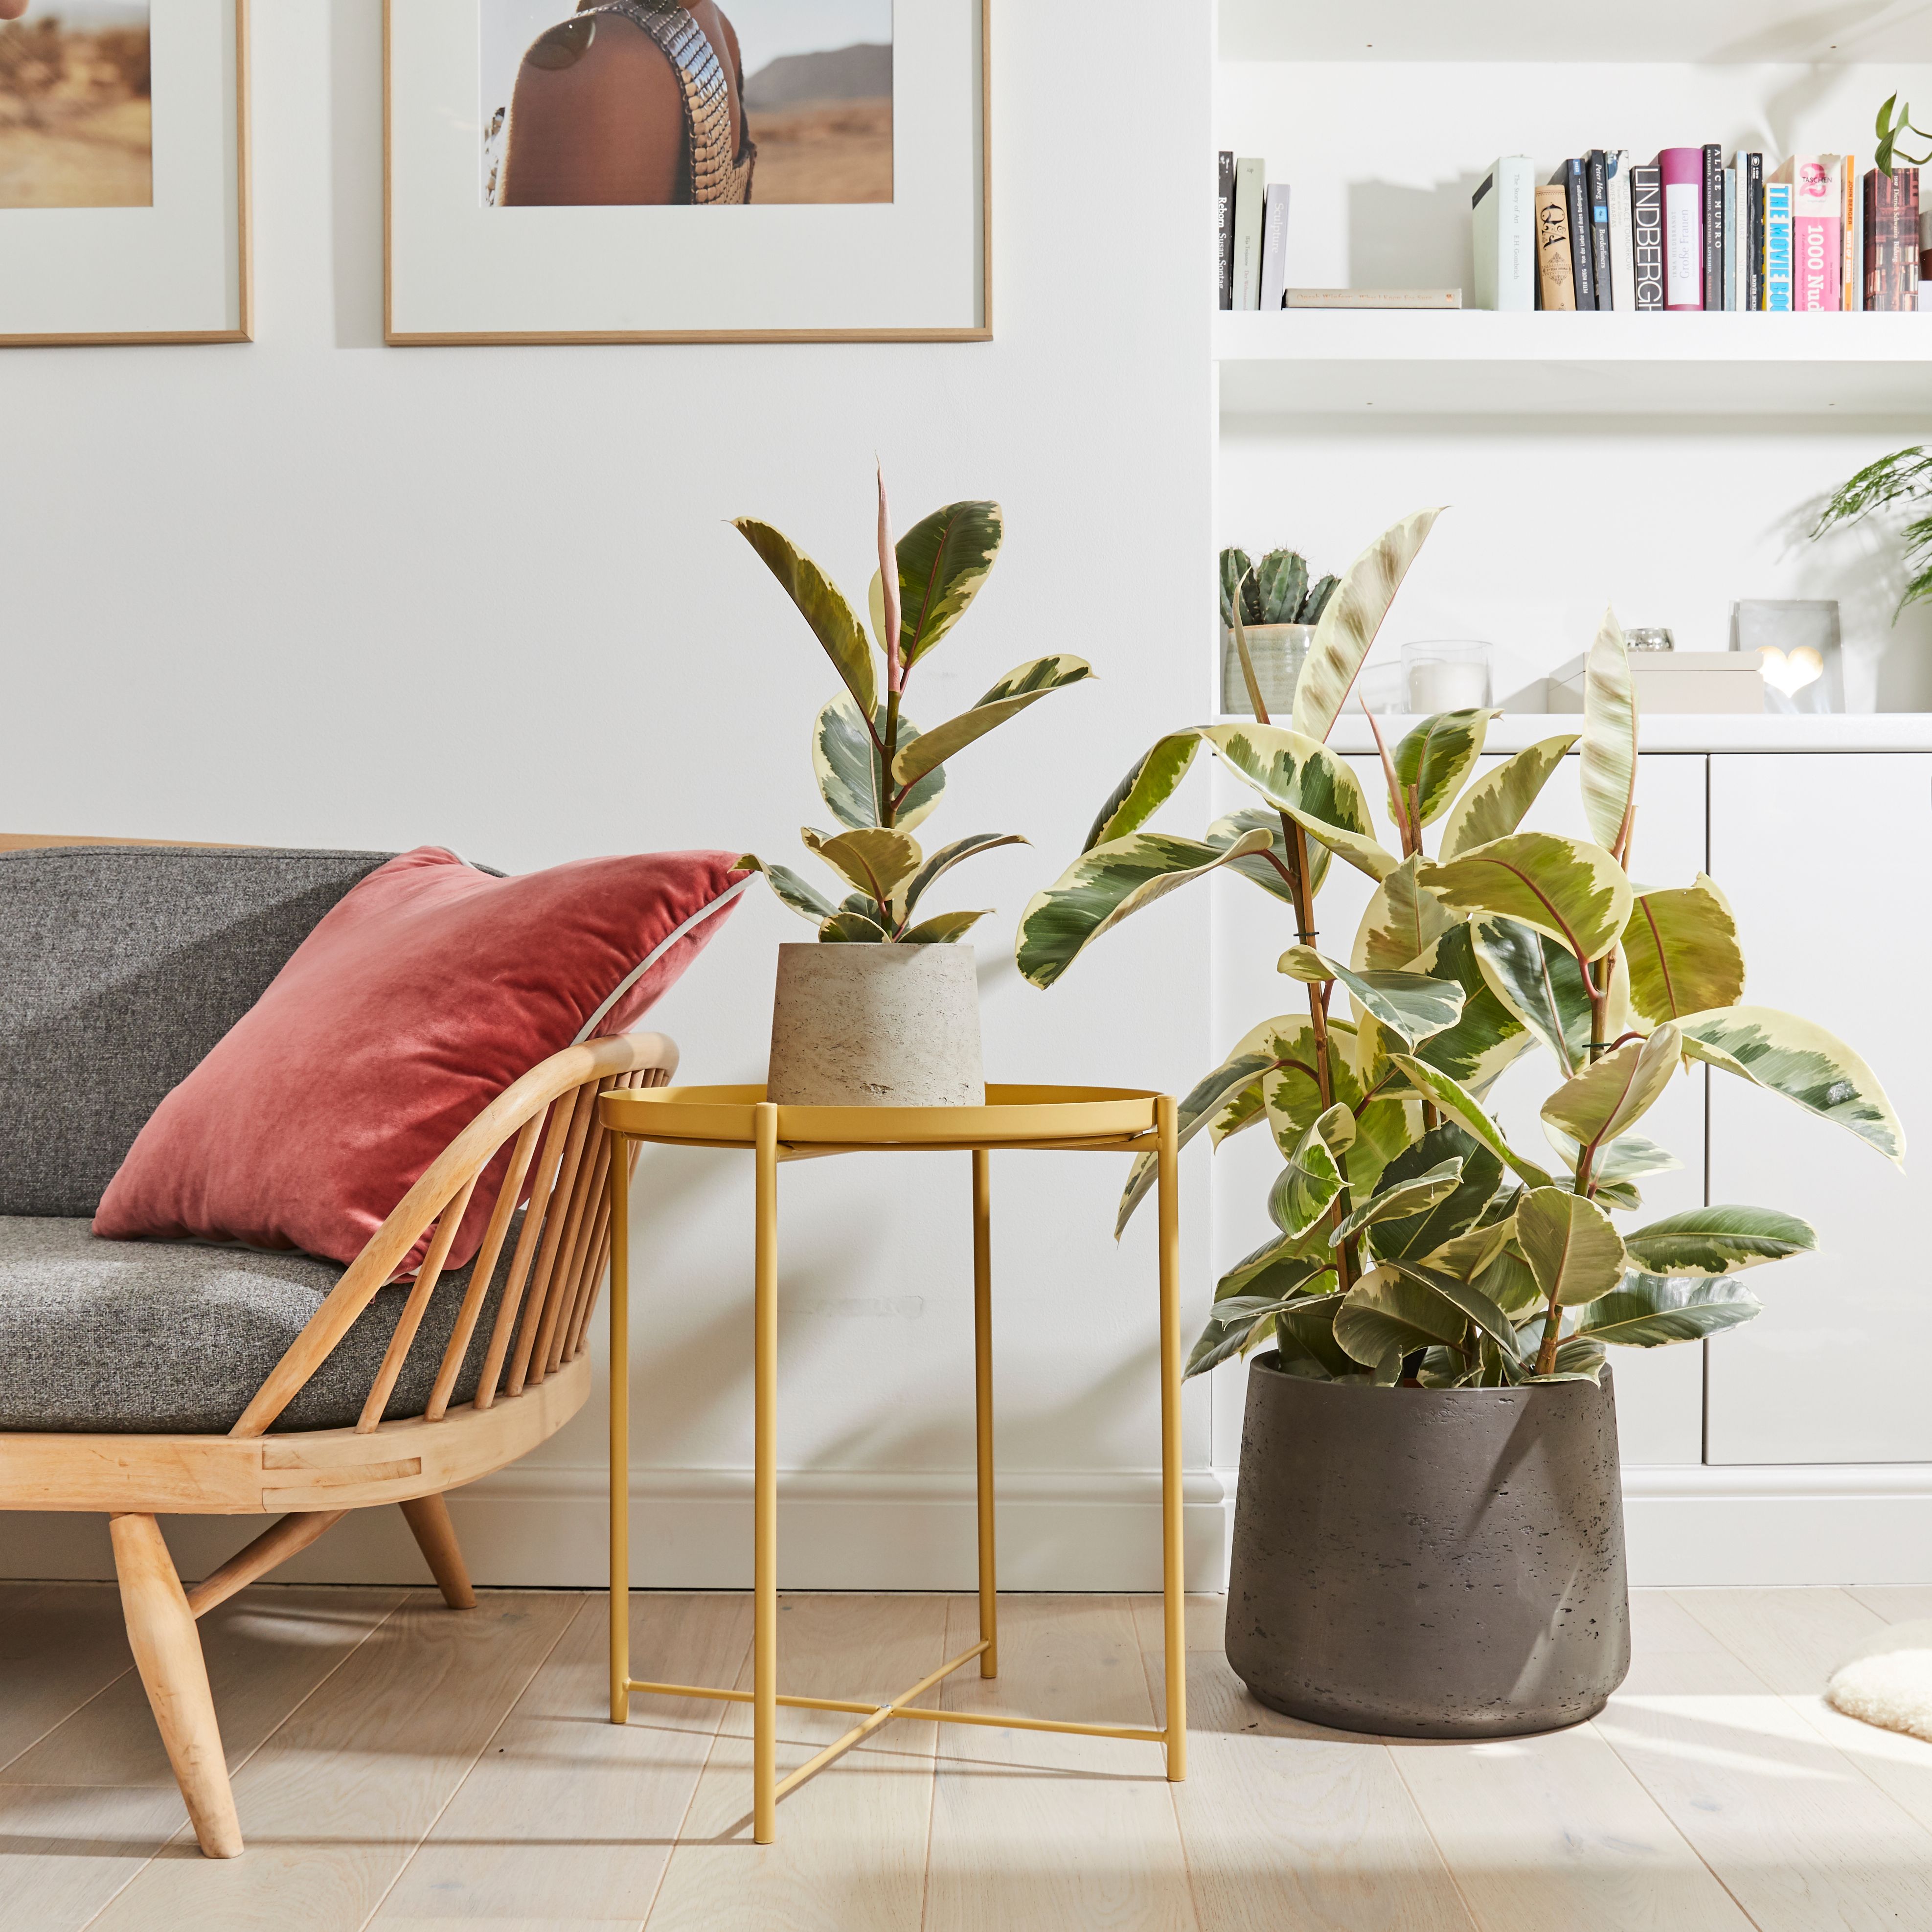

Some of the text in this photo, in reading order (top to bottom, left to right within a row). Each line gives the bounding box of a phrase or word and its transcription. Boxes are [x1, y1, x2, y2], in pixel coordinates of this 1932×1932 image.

[1218, 197, 1227, 227] Reborn
[1770, 185, 1789, 218] THE
[1272, 203, 1284, 253] Sculpture
[1598, 228, 1607, 269] Borderliners
[1624, 225, 1633, 271] TOMORROW
[1679, 209, 1690, 278] Große Frauen
[1769, 223, 1789, 278] MOVIE
[1807, 225, 1824, 270] 1000
[1846, 250, 1851, 258] OF
